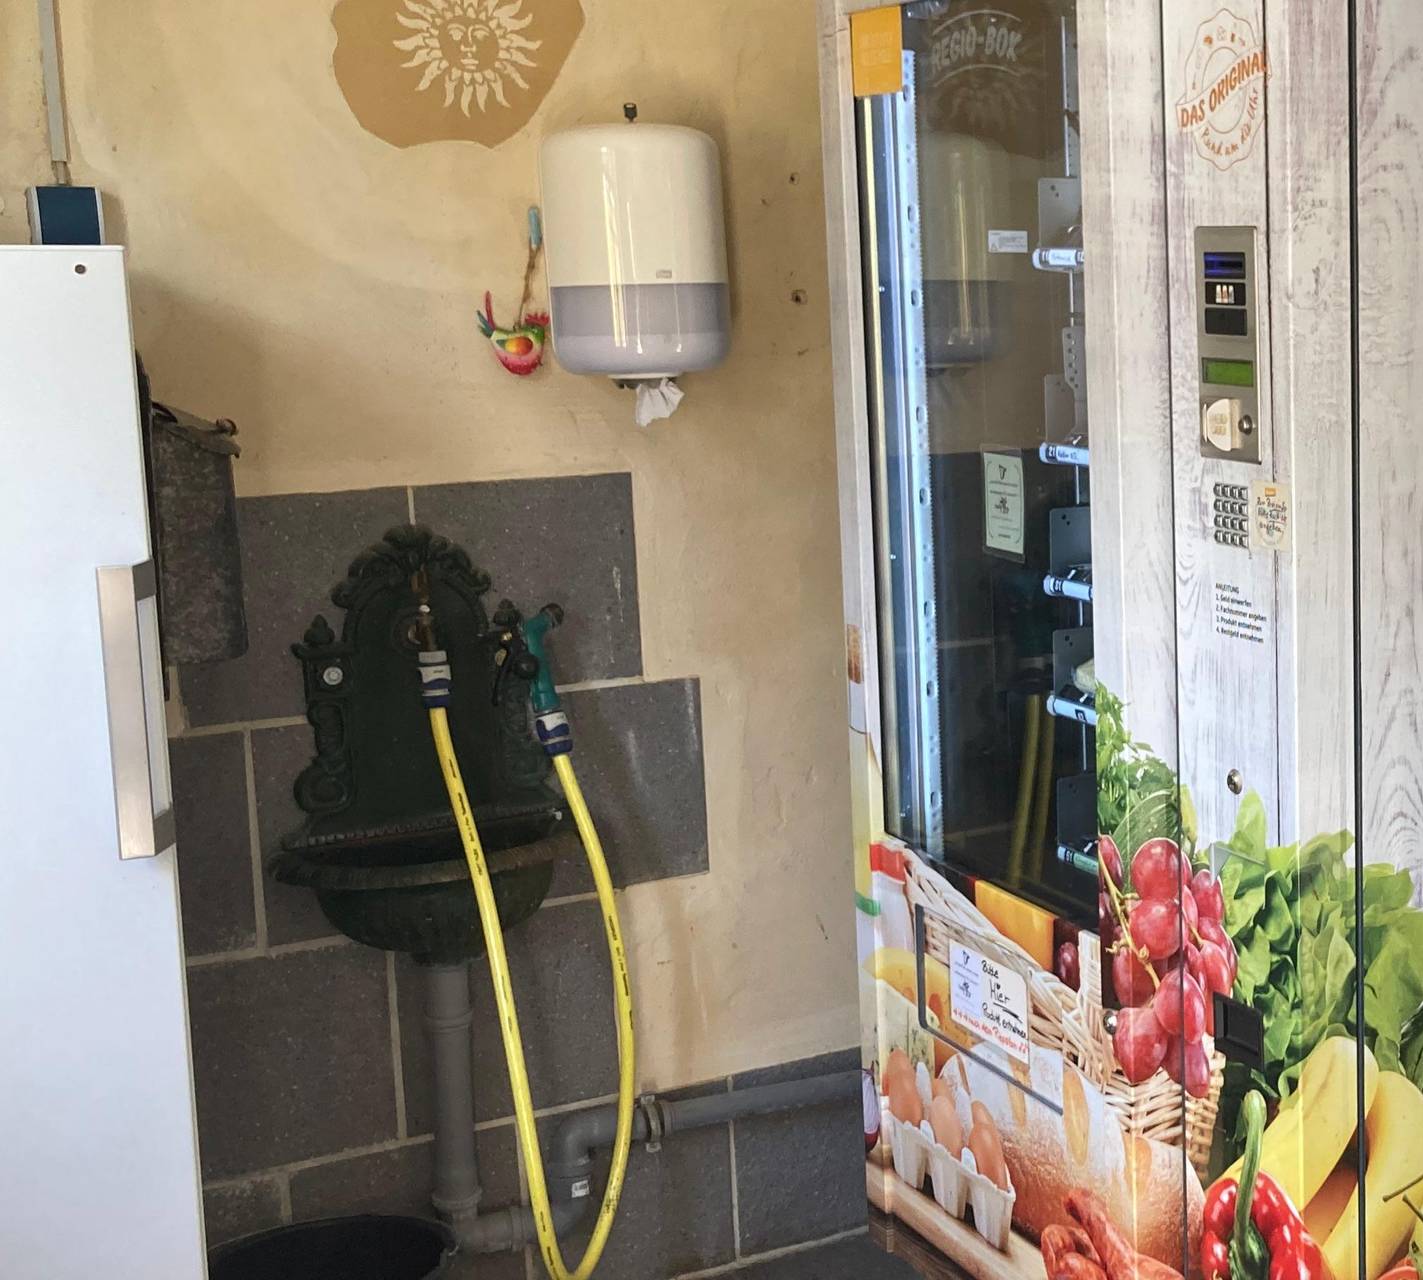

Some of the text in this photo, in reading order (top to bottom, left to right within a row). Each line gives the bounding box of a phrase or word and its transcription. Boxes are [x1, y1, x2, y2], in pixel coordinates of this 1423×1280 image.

[931, 25, 1022, 77] REGIO-BOX
[1180, 50, 1268, 128] DAS ORIGINAL
[989, 979, 1010, 1003] Hier
